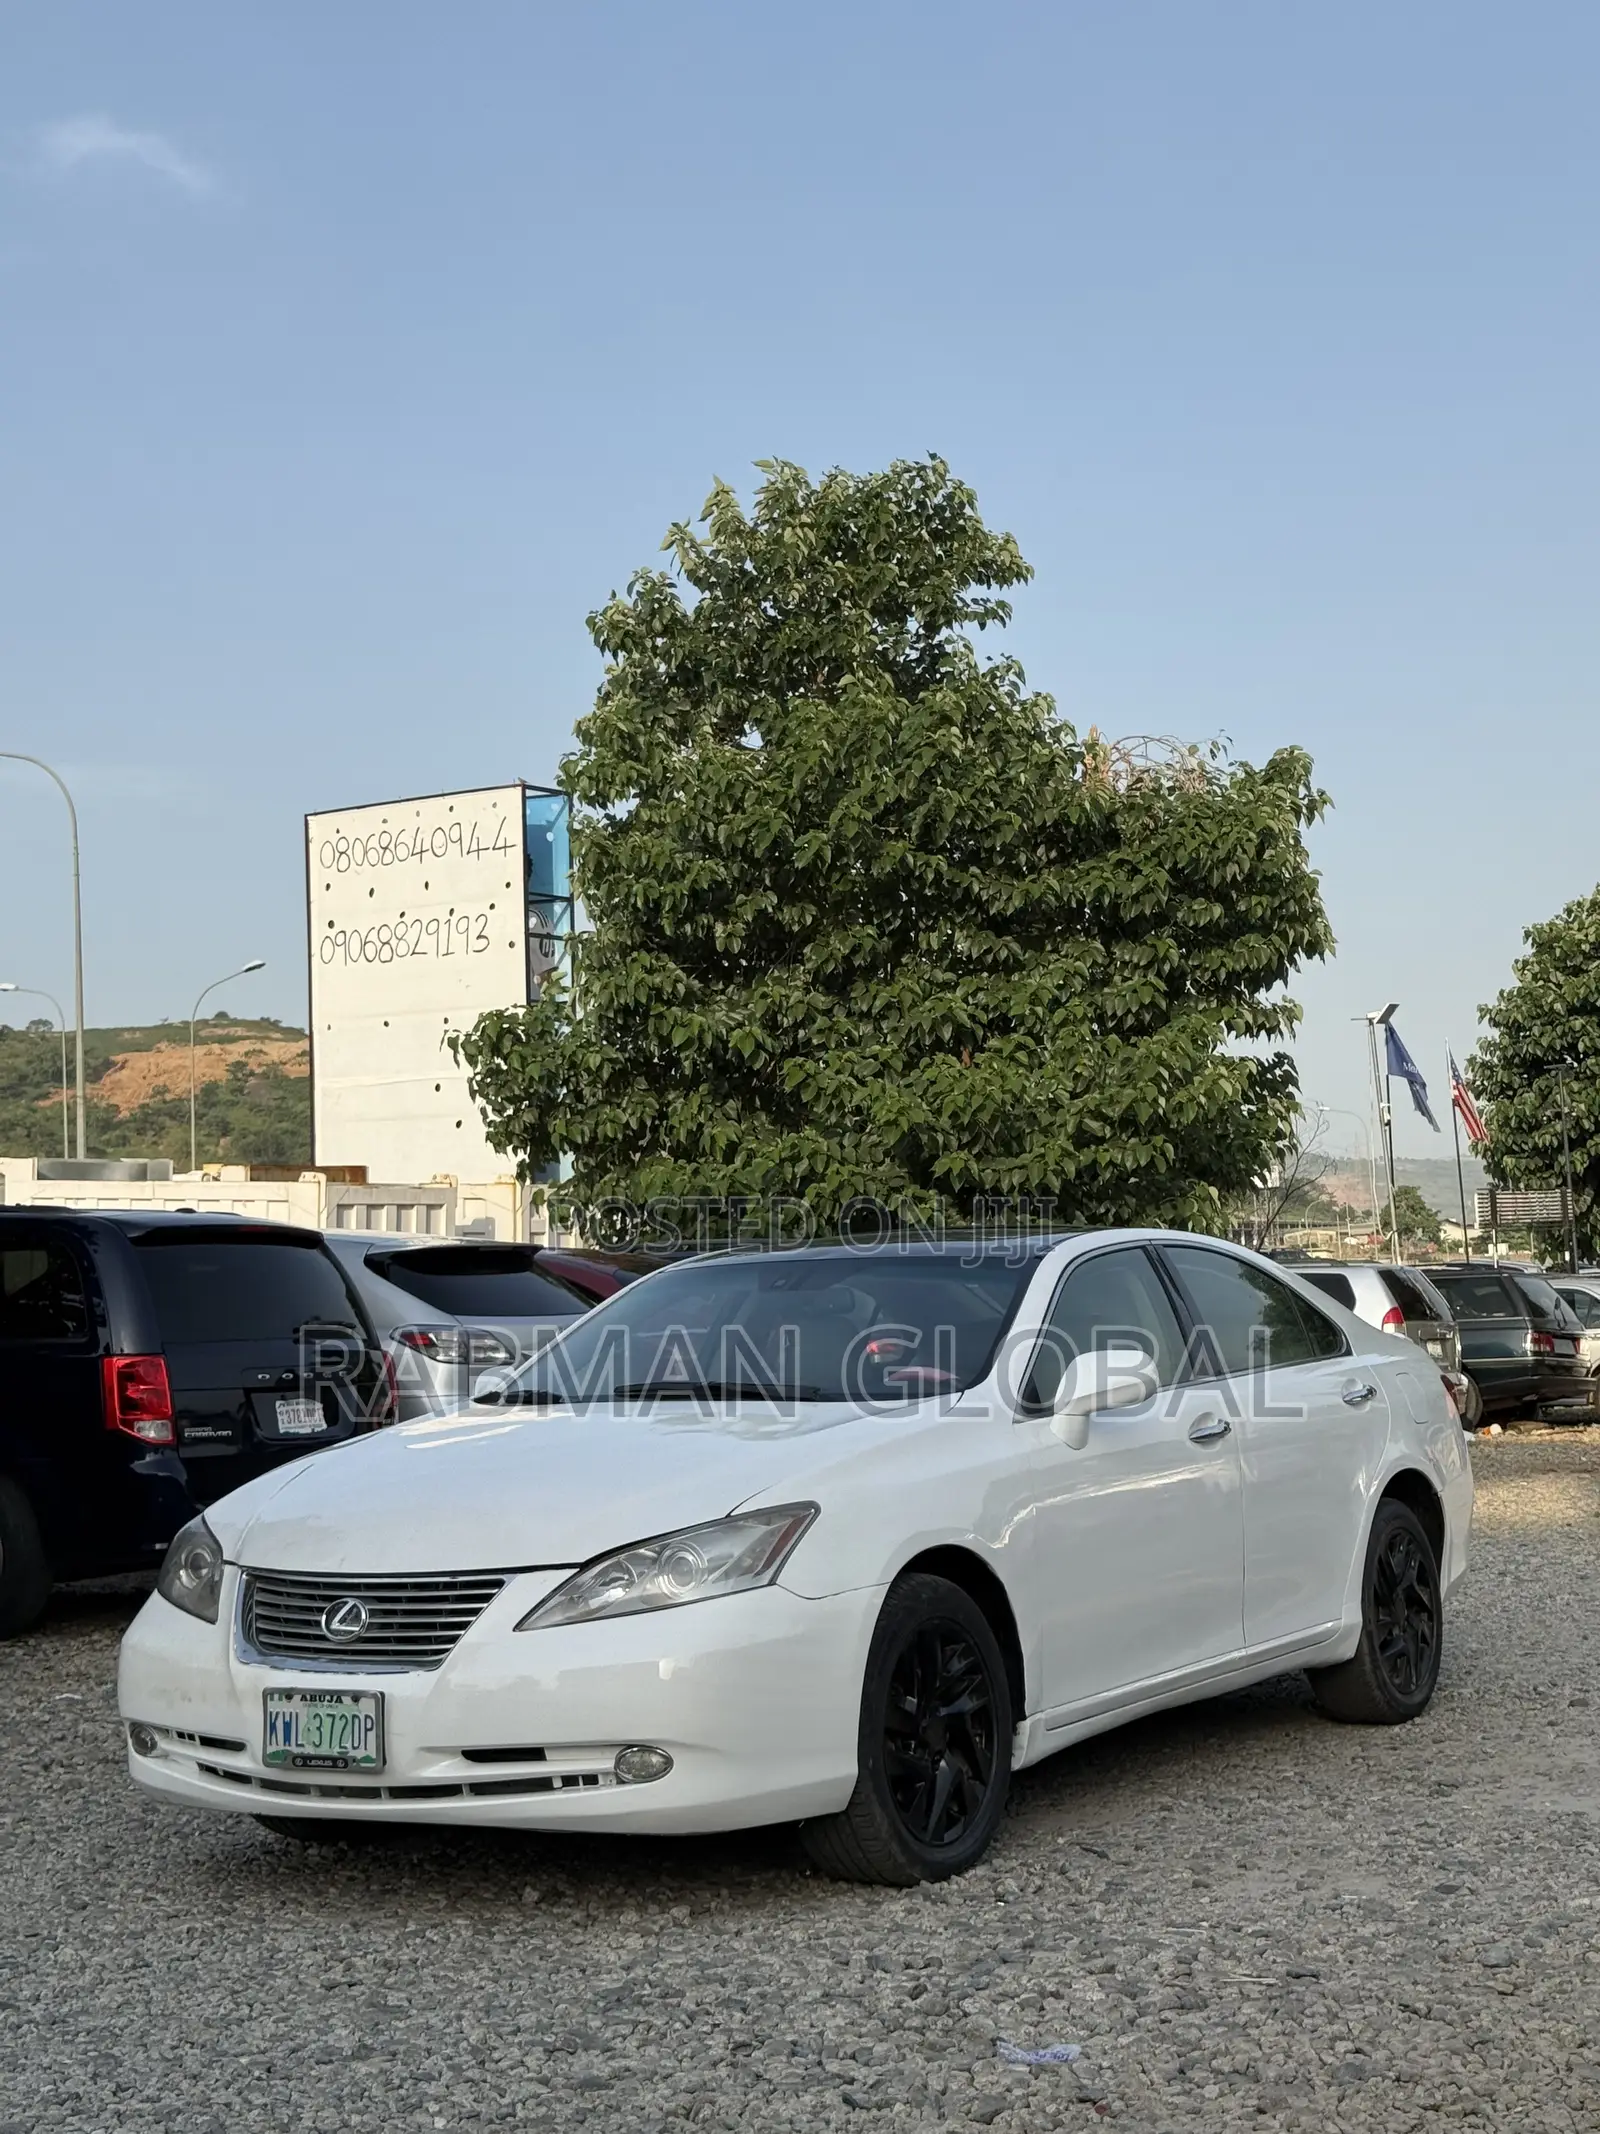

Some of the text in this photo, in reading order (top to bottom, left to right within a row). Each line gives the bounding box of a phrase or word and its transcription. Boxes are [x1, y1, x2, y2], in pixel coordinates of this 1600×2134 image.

[320, 816, 517, 872] 08068640944
[320, 913, 490, 966] 09068829193
[300, 1694, 343, 1704] ABUJA
